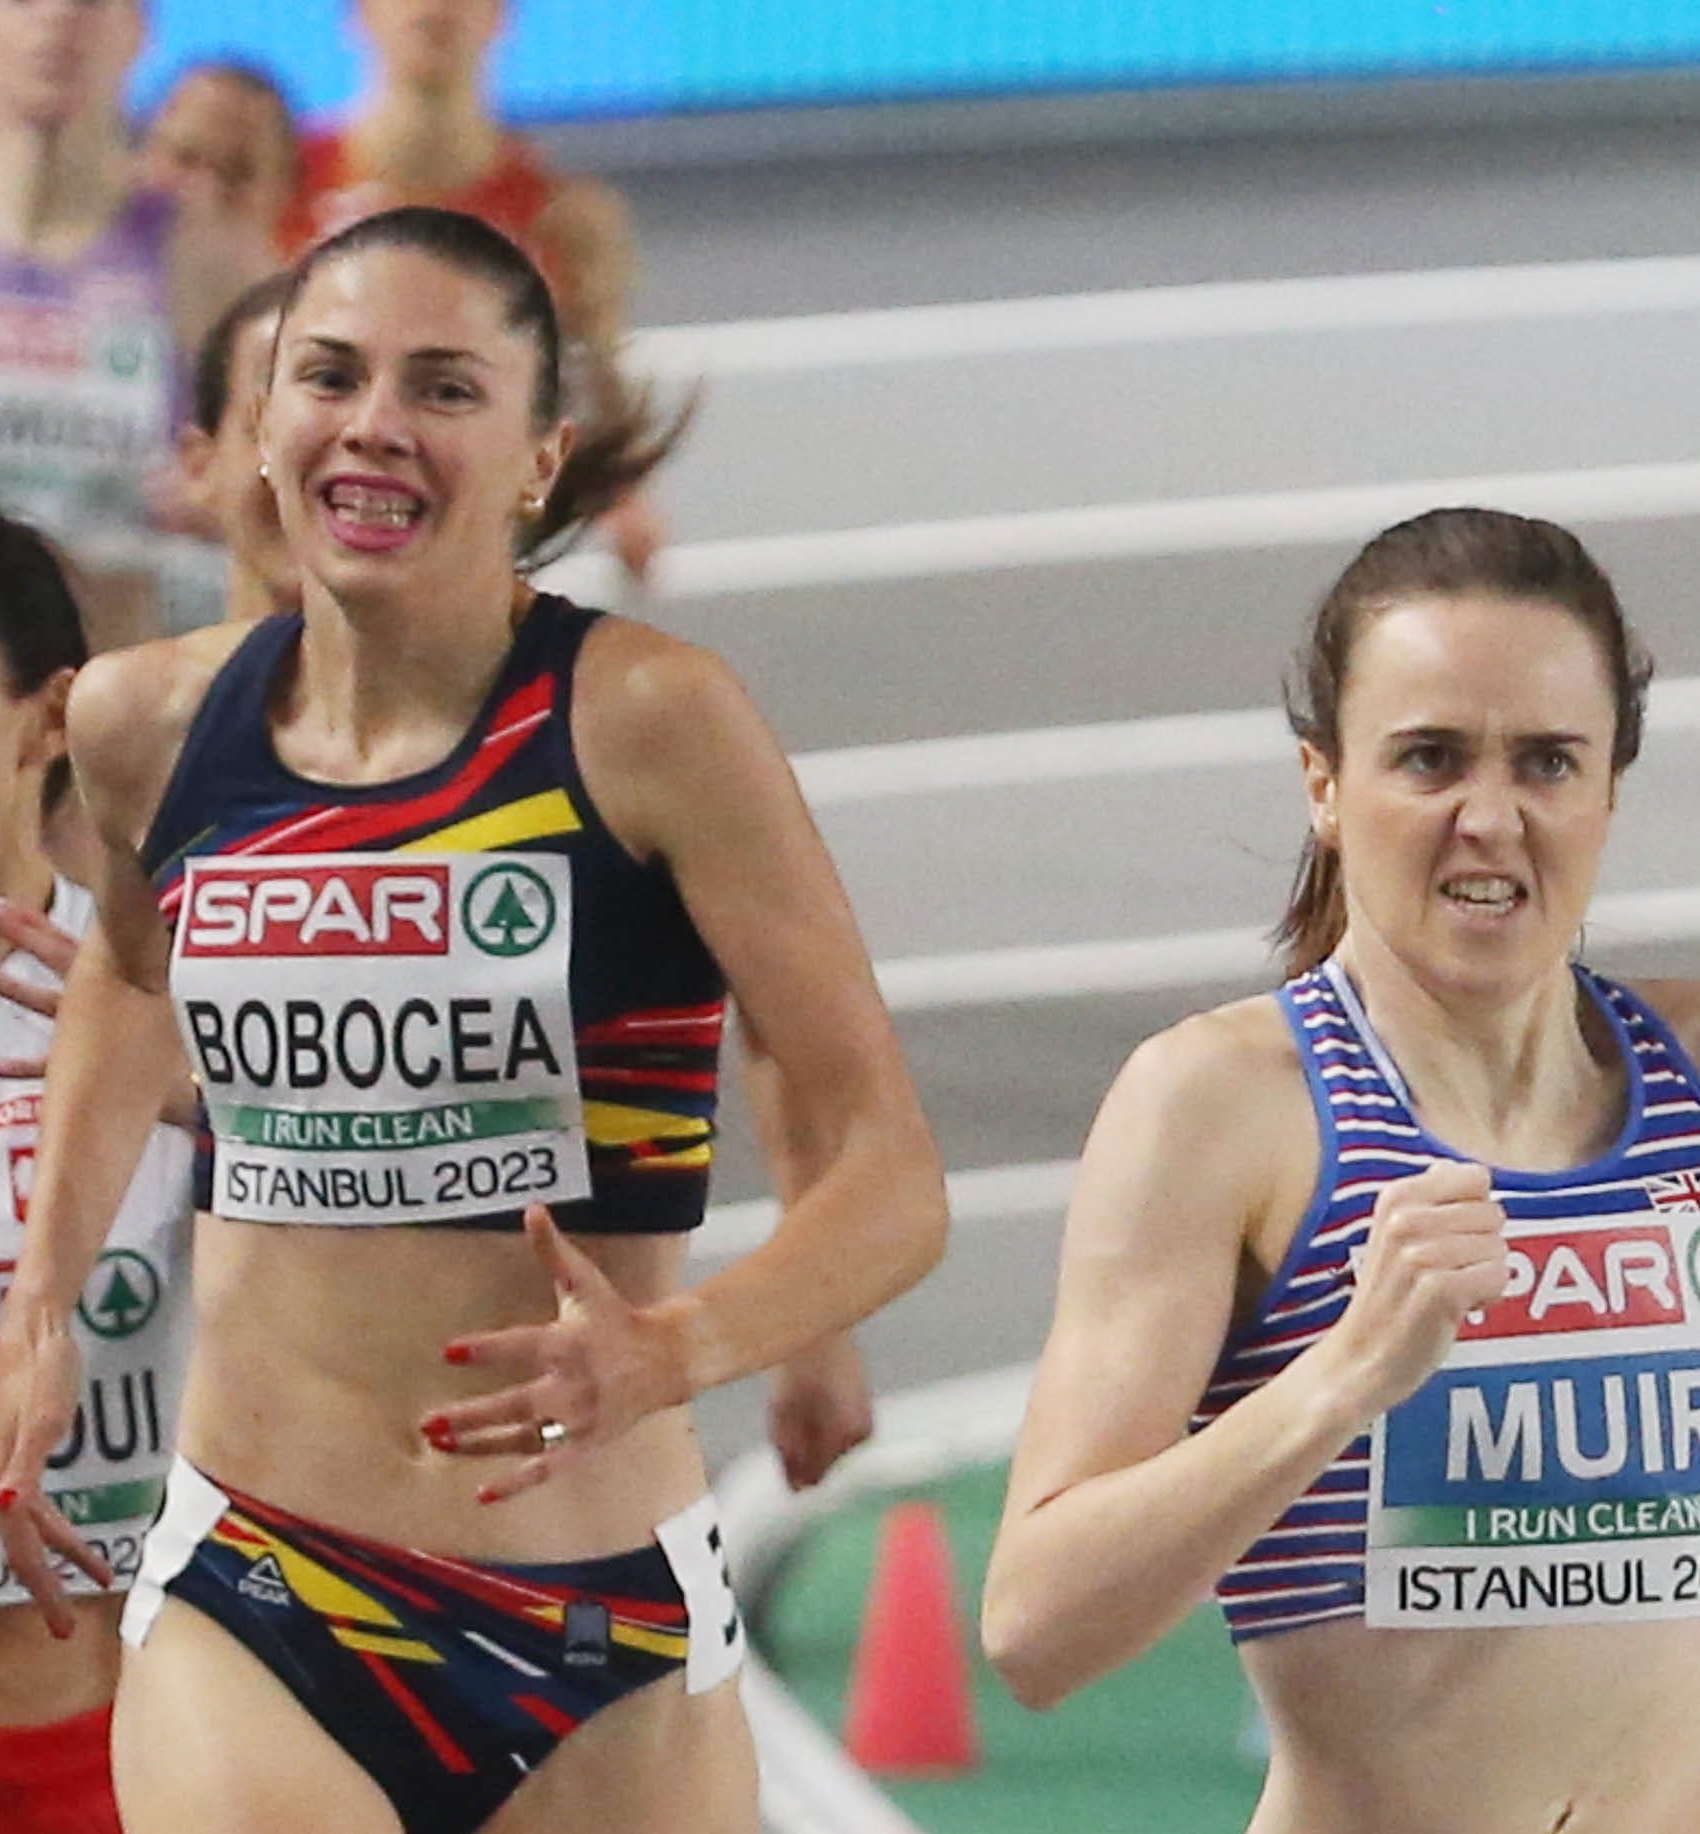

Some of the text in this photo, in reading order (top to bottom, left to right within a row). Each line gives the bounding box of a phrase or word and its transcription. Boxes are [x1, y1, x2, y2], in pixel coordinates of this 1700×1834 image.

[187, 875, 444, 947] SPAR
[185, 997, 561, 1090] BOBOCEA
[273, 1112, 342, 1147] RUN
[349, 1106, 474, 1146] CLEAN
[226, 1149, 558, 1210] ISTANBUL 2023
[1489, 1507, 1576, 1540] RUN
[1398, 1564, 1661, 1612] ISTANBUL
